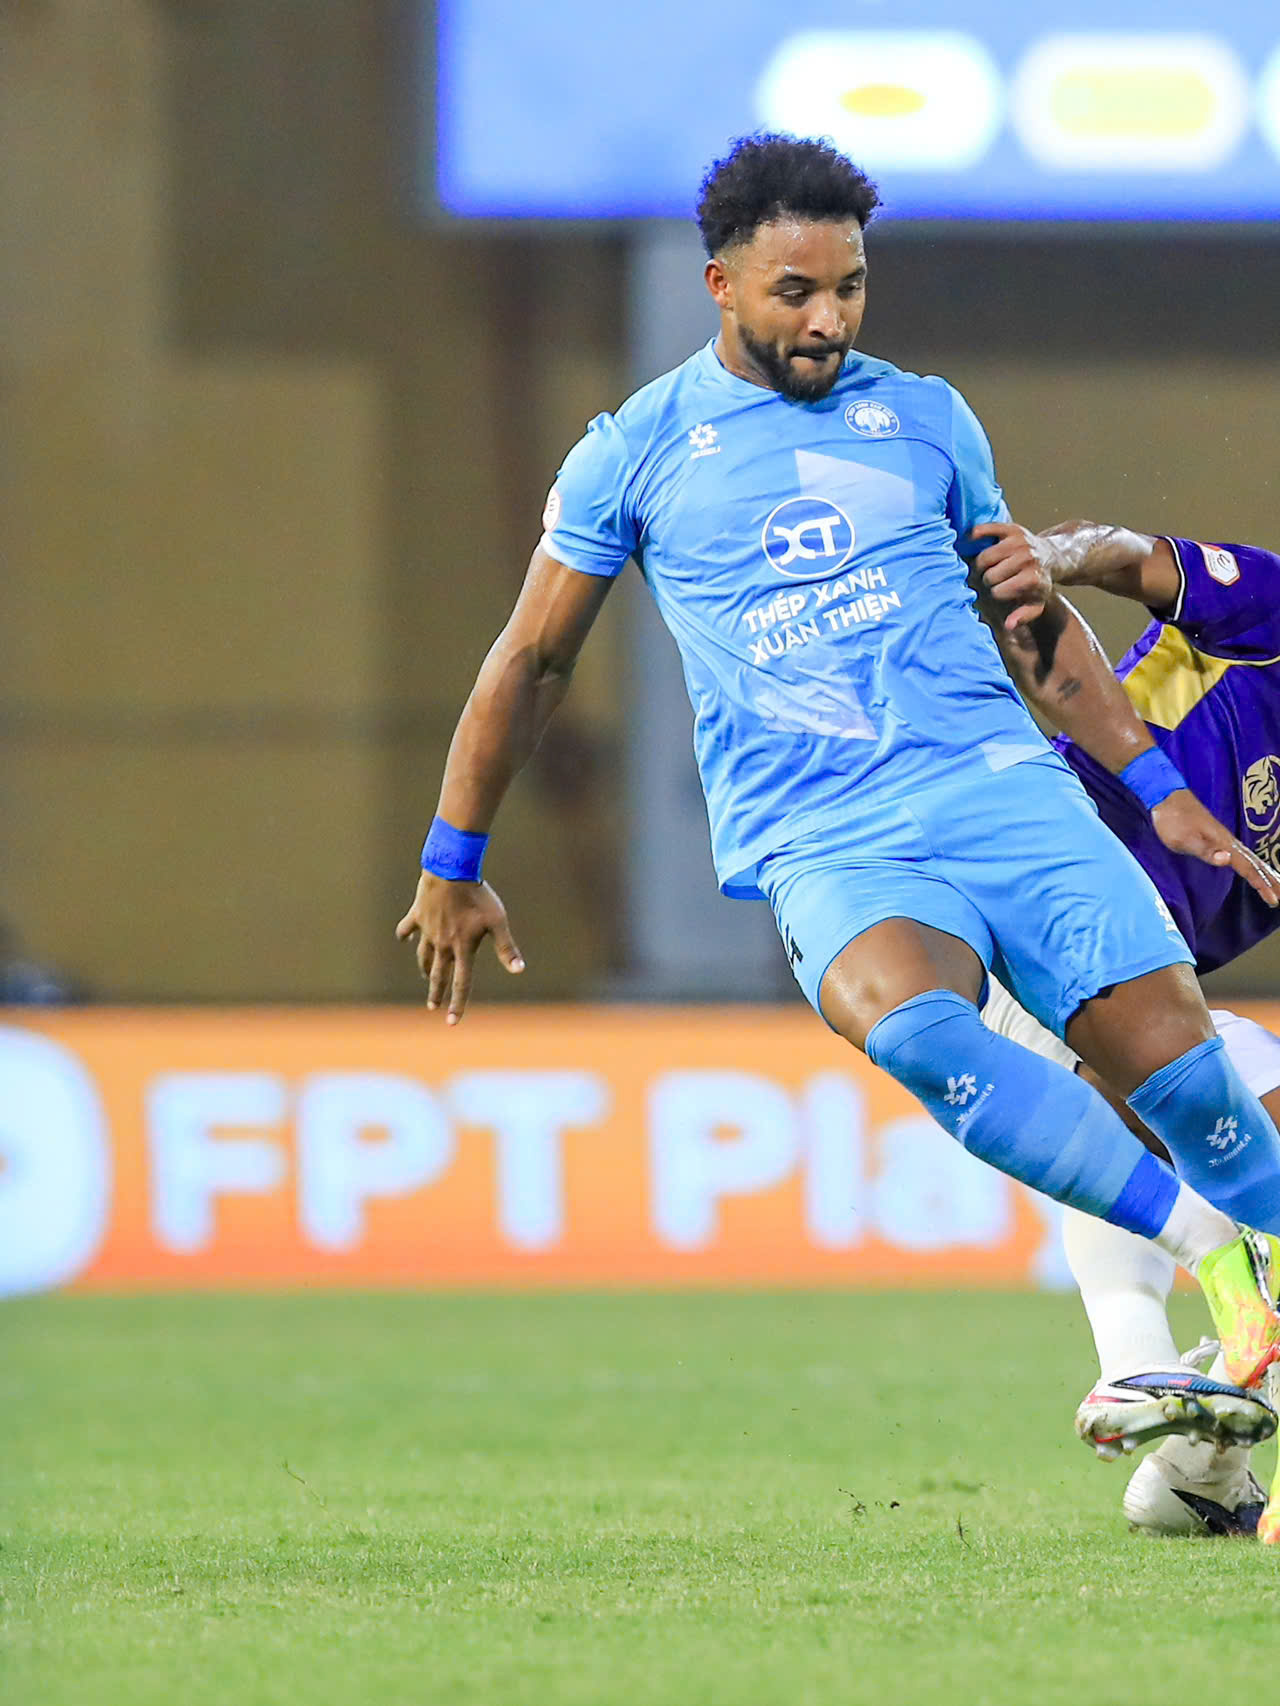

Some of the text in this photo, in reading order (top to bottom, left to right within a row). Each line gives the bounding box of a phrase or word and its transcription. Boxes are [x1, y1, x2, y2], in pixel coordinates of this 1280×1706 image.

[742, 566, 888, 633] THÉP XANH
[748, 591, 902, 665] XUÂN THIỆN
[146, 1070, 607, 1253] FPT
